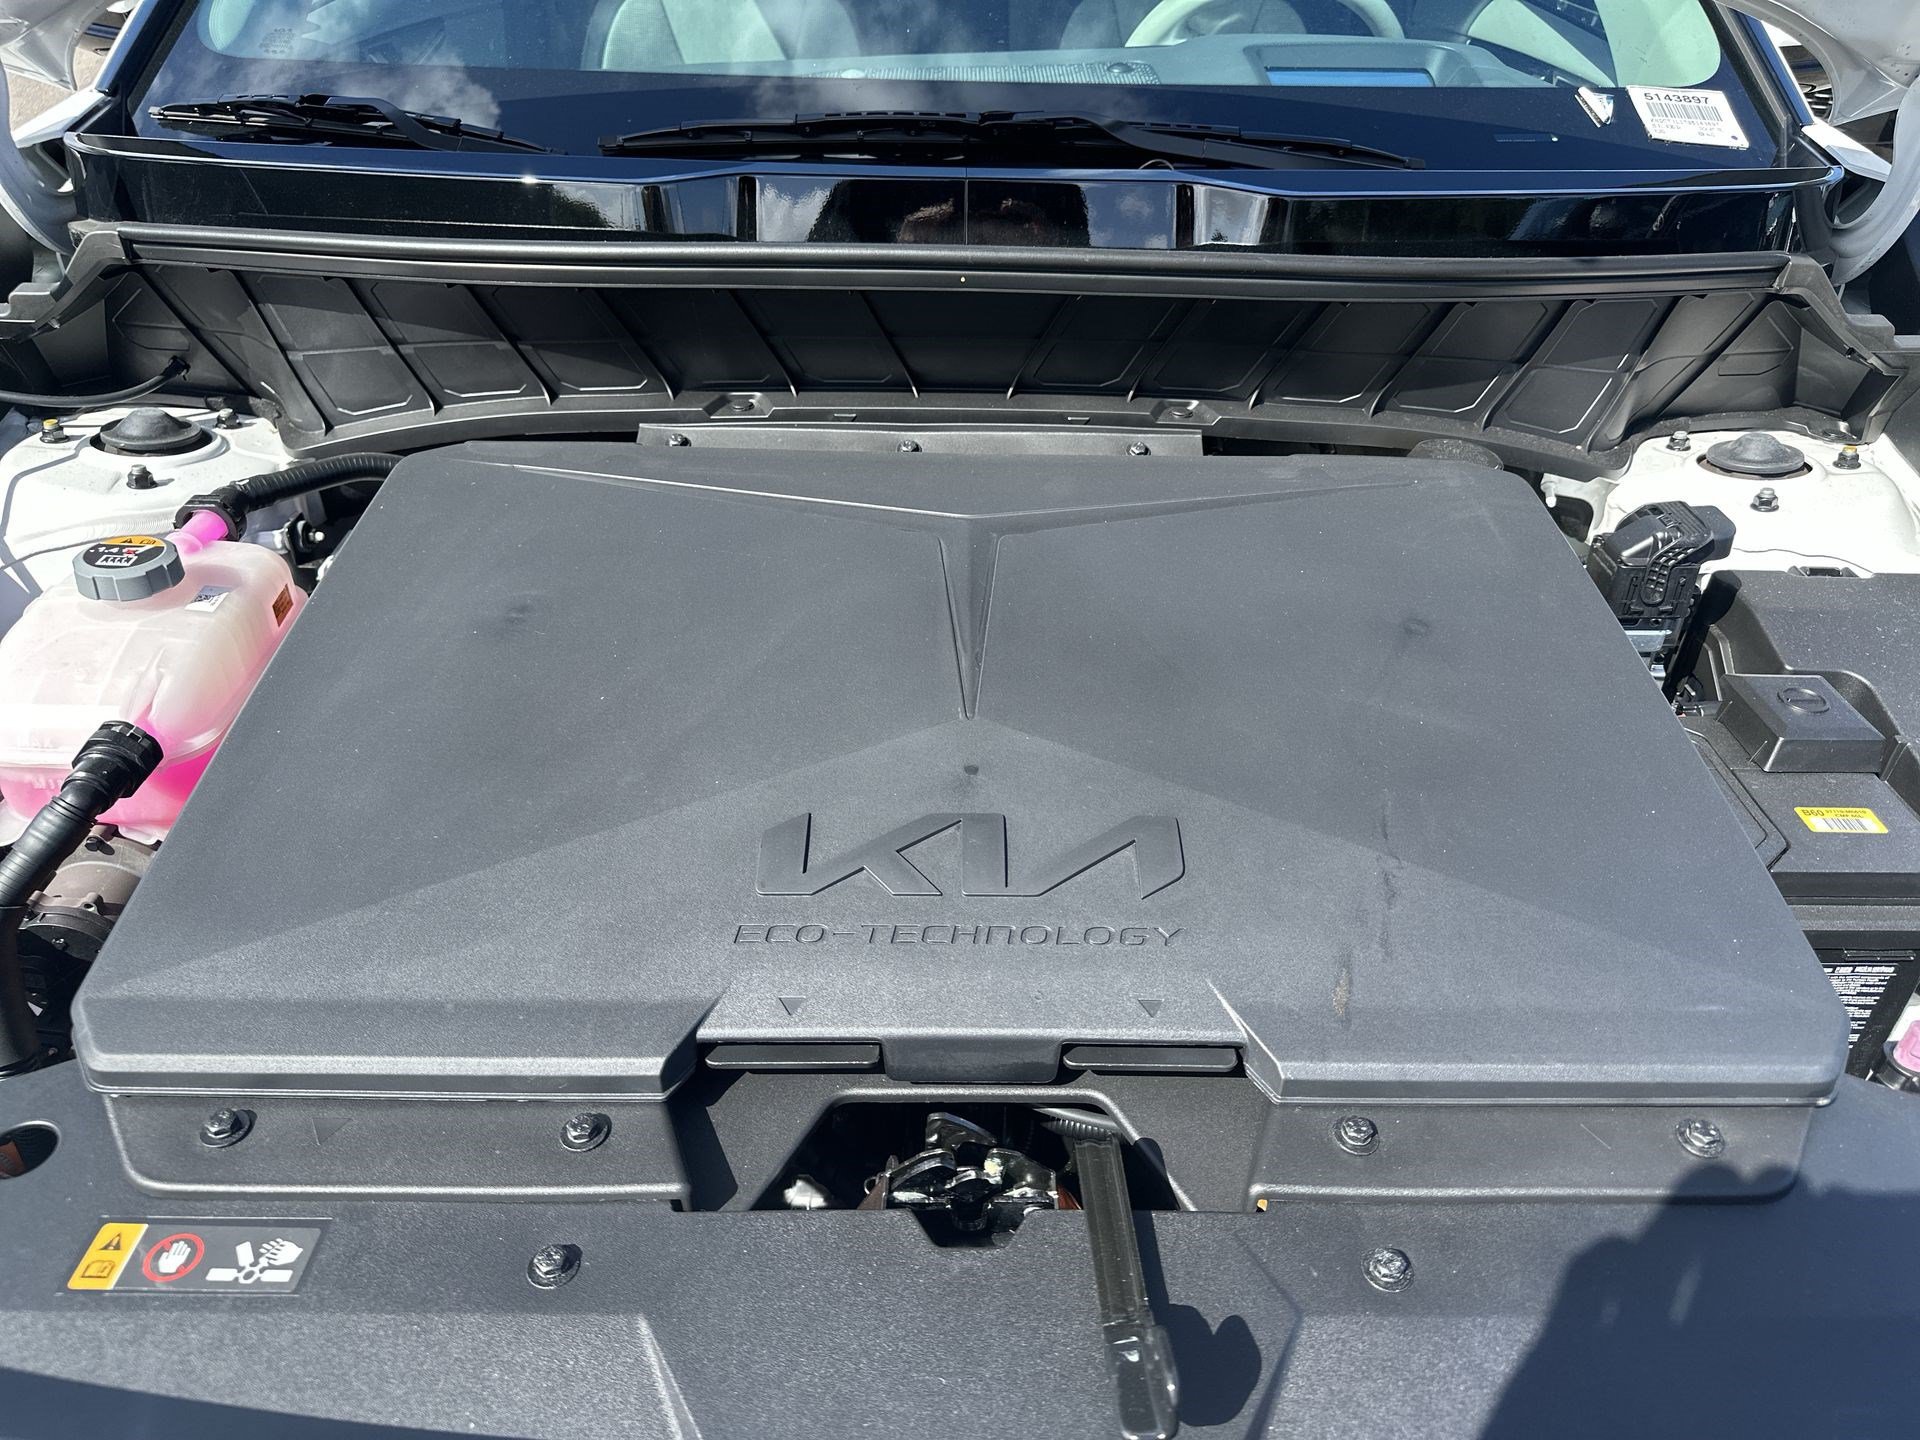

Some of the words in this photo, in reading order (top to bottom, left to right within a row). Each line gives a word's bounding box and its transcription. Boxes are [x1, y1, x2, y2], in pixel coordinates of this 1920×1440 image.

[1644, 92, 1710, 105] 5143897
[1801, 809, 1825, 817] B60
[755, 812, 1186, 900] KIA
[733, 923, 1186, 947] ECO-TECHNOLOGY
